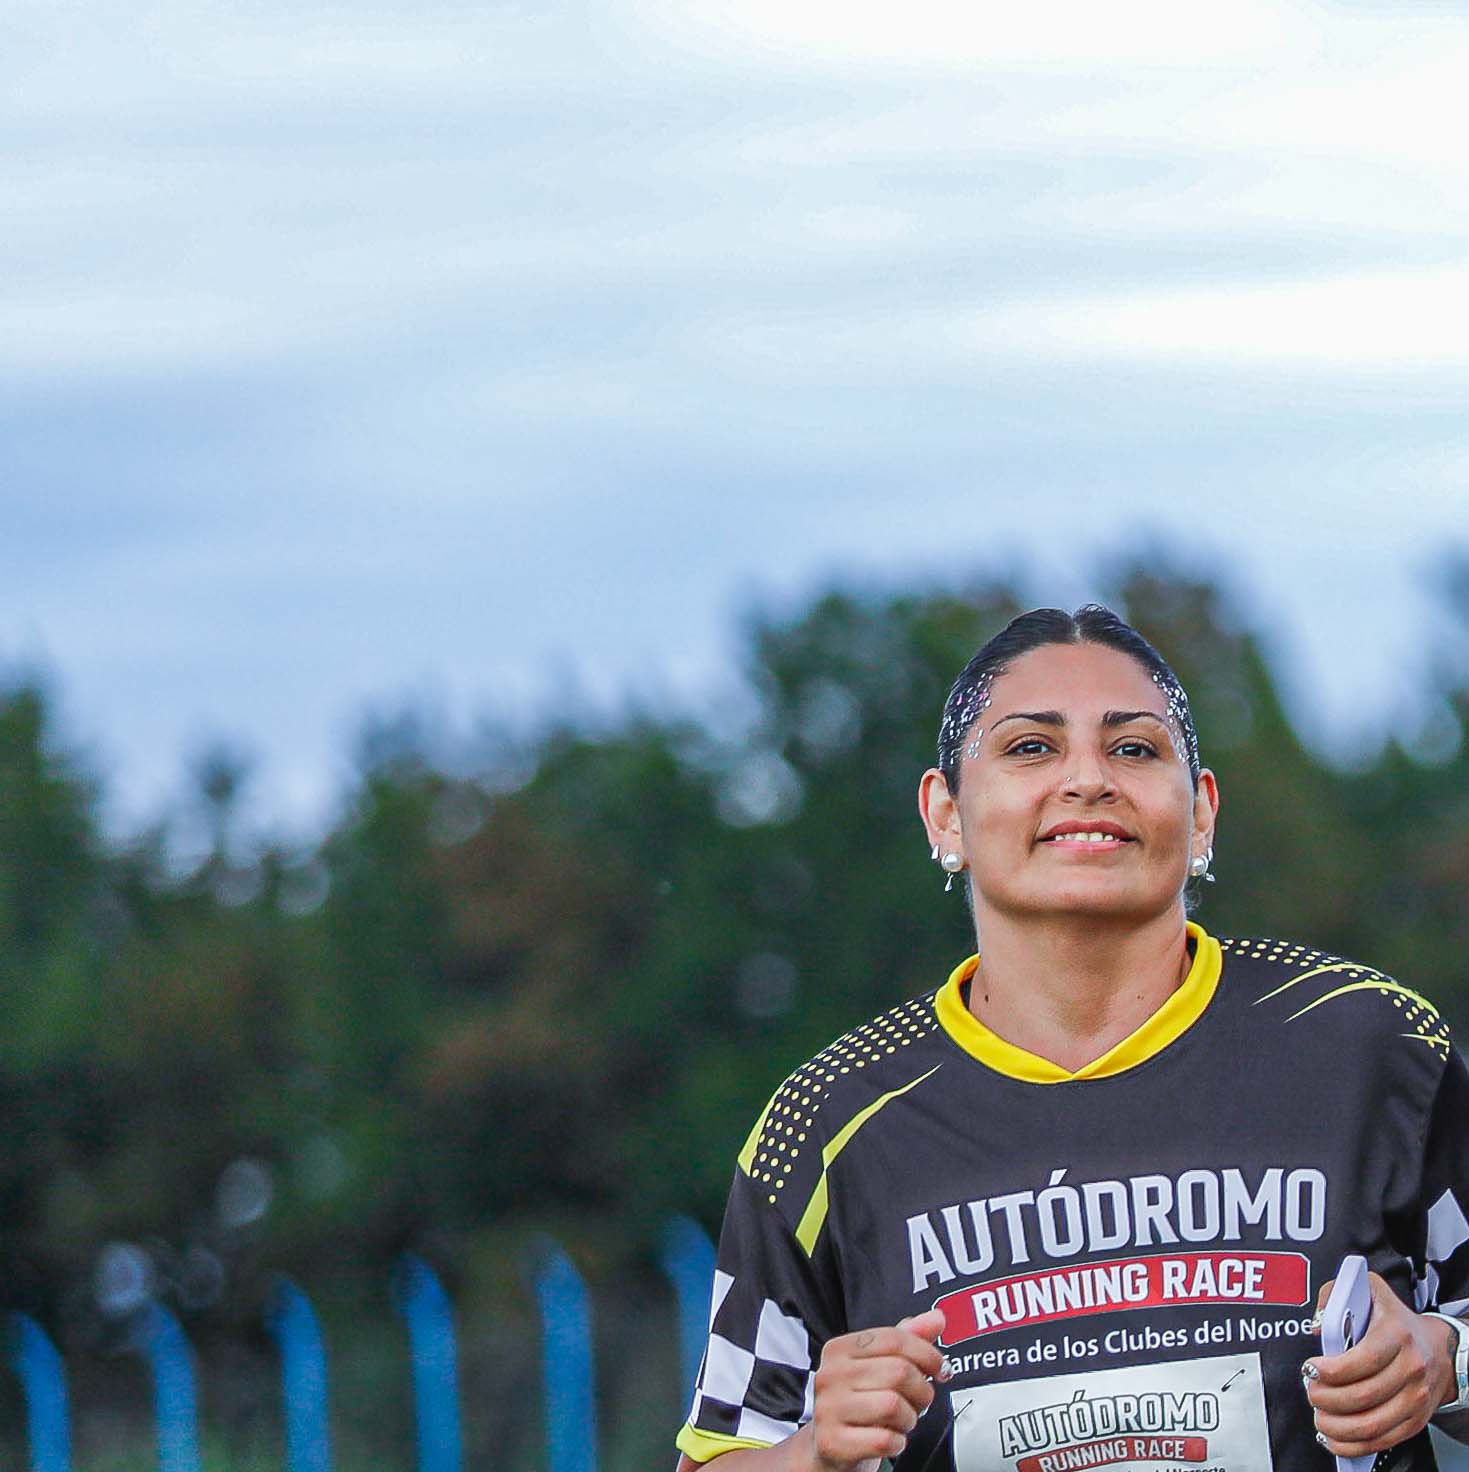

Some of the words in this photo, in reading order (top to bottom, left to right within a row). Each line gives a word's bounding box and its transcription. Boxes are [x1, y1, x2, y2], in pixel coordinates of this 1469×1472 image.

[905, 1168, 1327, 1295] AUTÓDROMO
[970, 1264, 1149, 1331] RUNNING
[1161, 1259, 1266, 1300] RACE
[943, 1348, 1020, 1376] arrera
[1026, 1339, 1058, 1363] de
[1063, 1335, 1099, 1359] los
[1104, 1326, 1188, 1354] Clubes
[1194, 1320, 1232, 1345] del
[999, 1390, 1219, 1458] AUTÓDROMO
[1133, 1439, 1186, 1459] RACE
